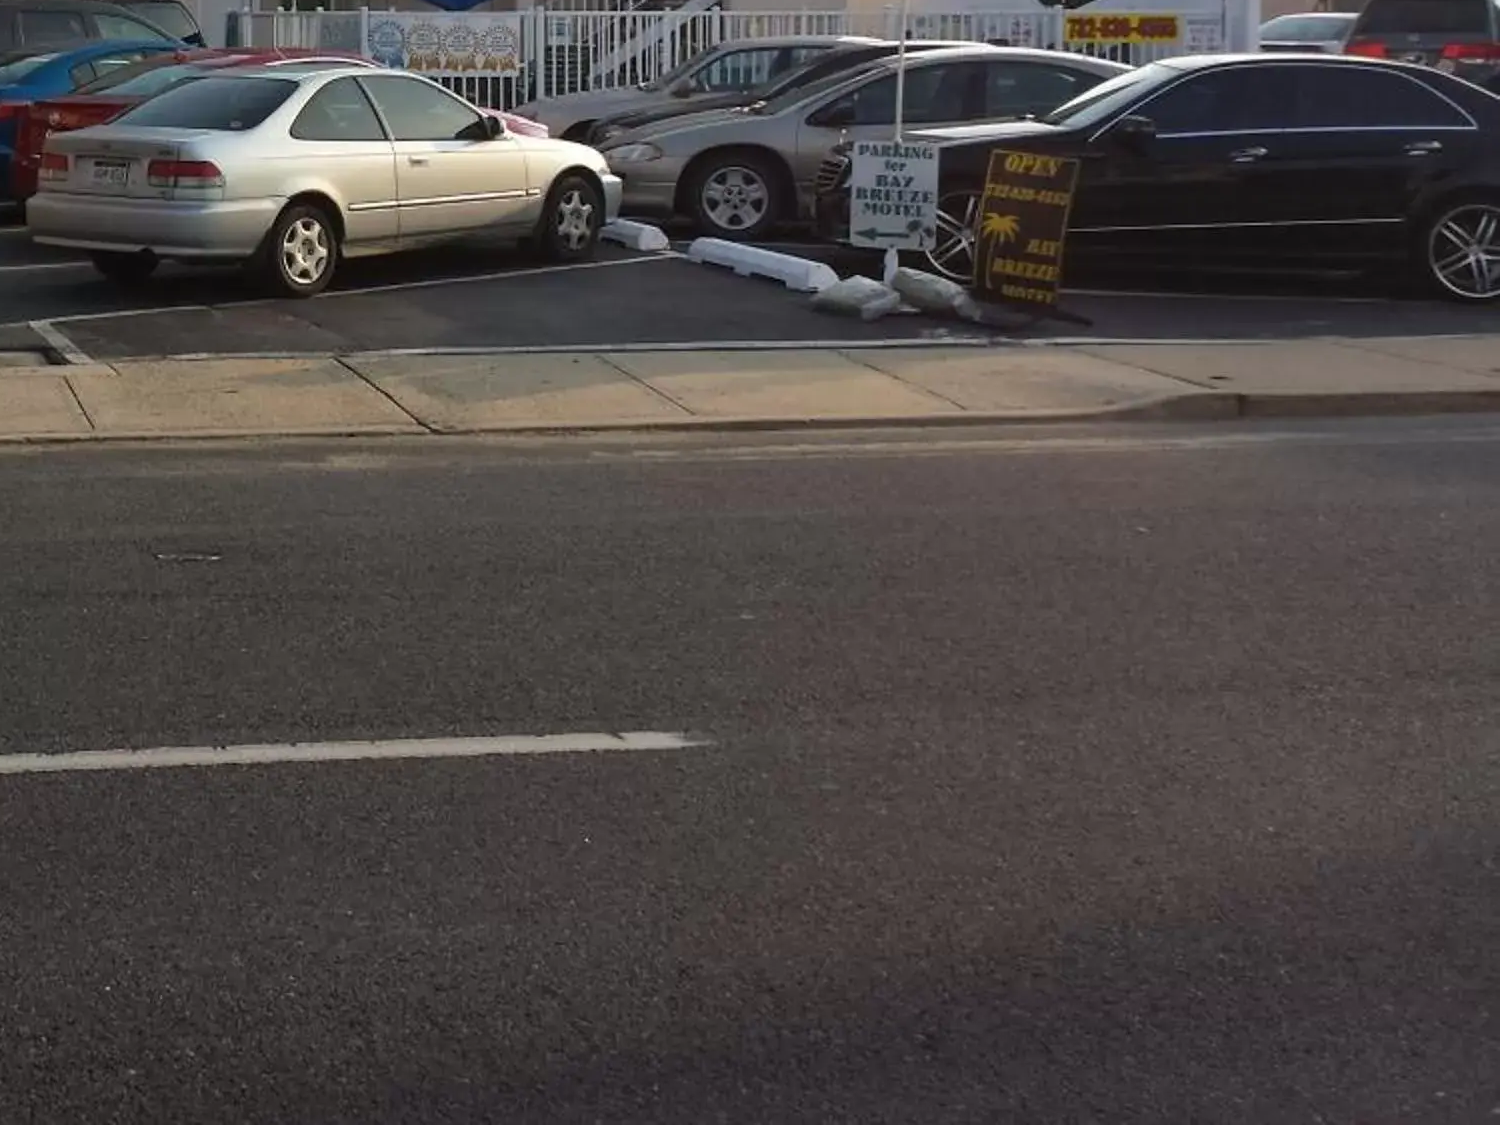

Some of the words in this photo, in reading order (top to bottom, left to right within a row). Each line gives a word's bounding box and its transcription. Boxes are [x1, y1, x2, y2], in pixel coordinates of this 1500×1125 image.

[858, 143, 934, 160] PARKING
[884, 159, 908, 172] for
[1004, 154, 1064, 178] OPEN
[876, 174, 915, 188] BAY
[855, 187, 934, 204] BREEZE
[861, 202, 928, 218] MOTEL
